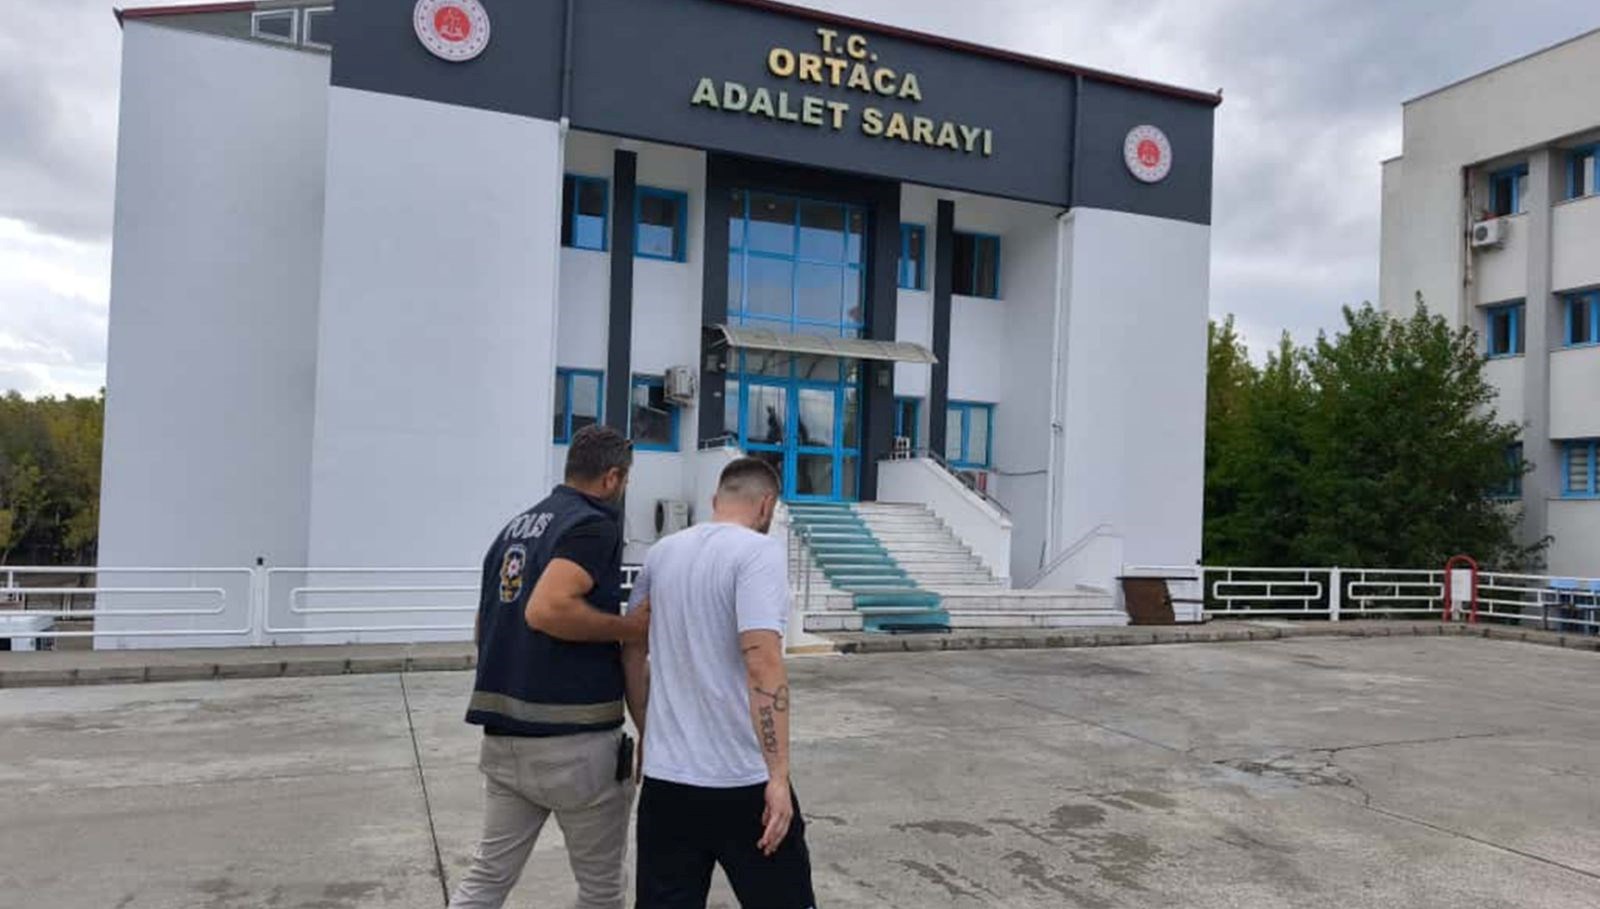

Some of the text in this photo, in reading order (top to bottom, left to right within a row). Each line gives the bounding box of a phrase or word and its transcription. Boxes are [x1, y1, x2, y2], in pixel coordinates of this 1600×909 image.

[817, 28, 878, 61] T.C.
[768, 47, 922, 101] ORTACA
[690, 77, 993, 156] ADALET SARAYI
